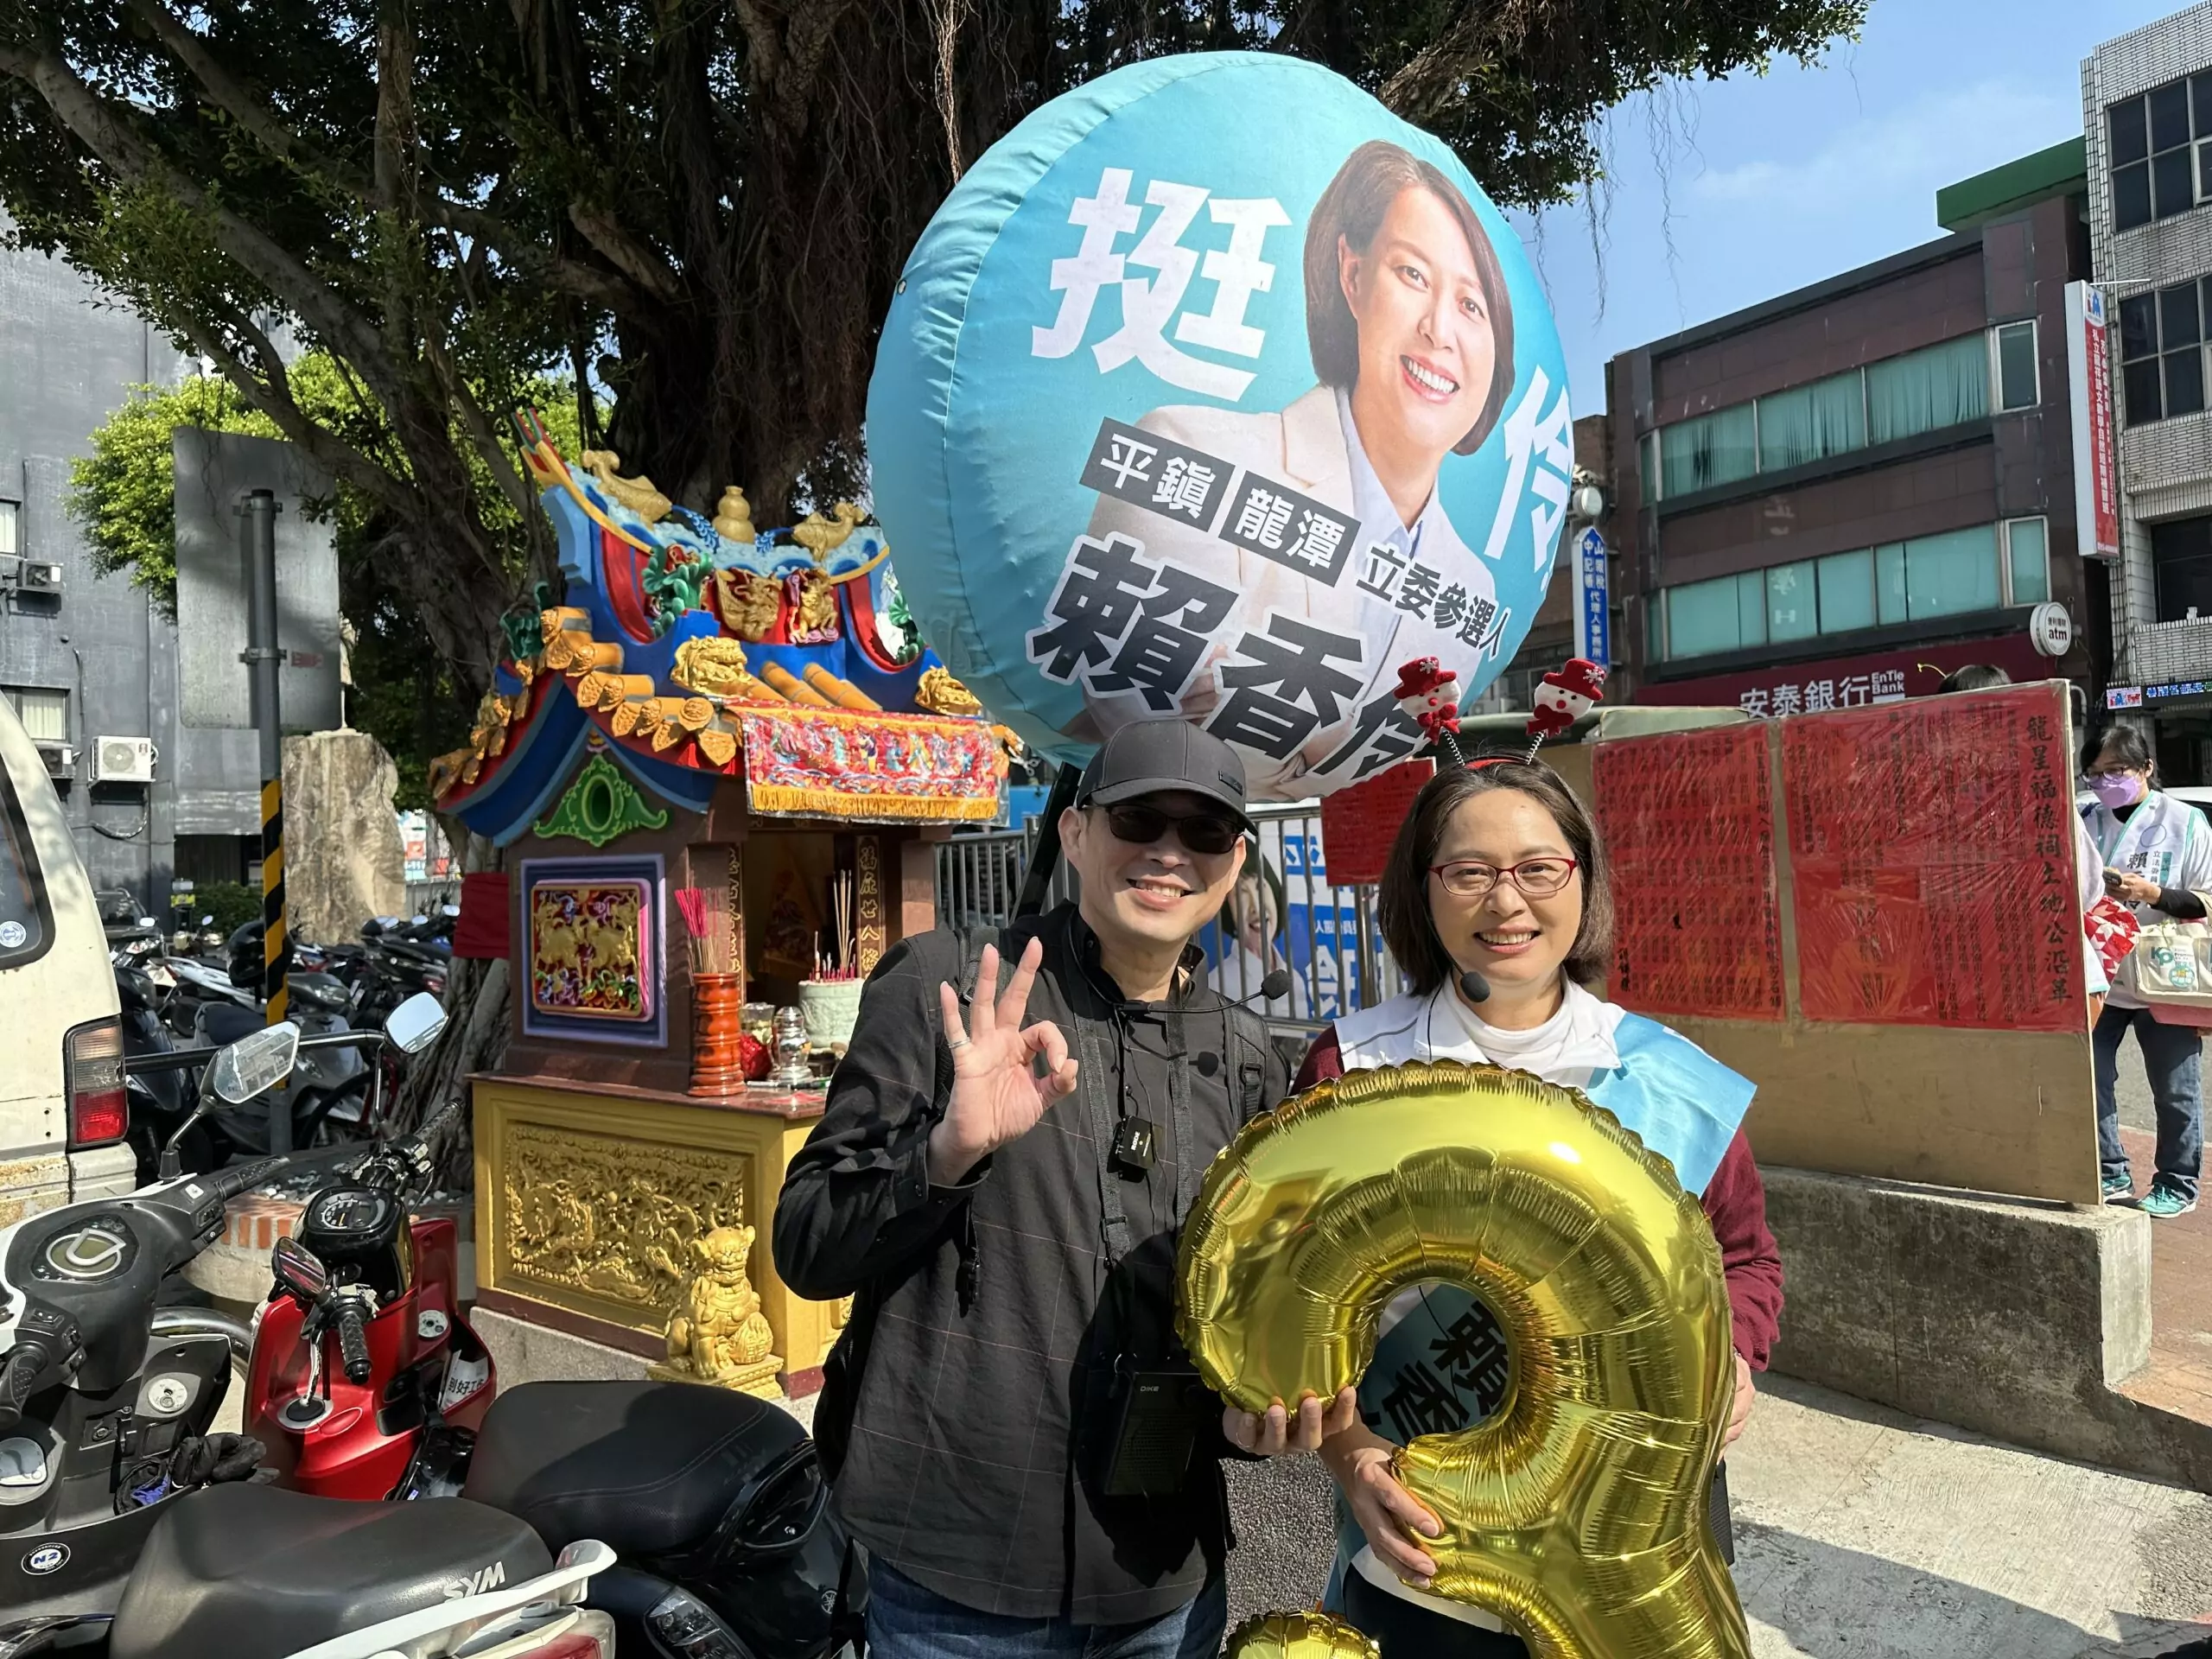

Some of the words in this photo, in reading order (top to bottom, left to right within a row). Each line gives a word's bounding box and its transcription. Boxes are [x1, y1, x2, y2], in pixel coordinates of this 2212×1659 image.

[1031, 167, 1294, 401] 挺
[1100, 433, 1216, 520] 平鎮
[1233, 485, 1344, 570] 龍潭
[1355, 544, 1513, 660] 立委參選人
[2049, 627, 2068, 641] atm
[1872, 670, 1904, 684] EnTie
[1872, 681, 1904, 695] Bank
[1740, 675, 1870, 719] 安泰銀行
[442, 1560, 505, 1599] SYM
